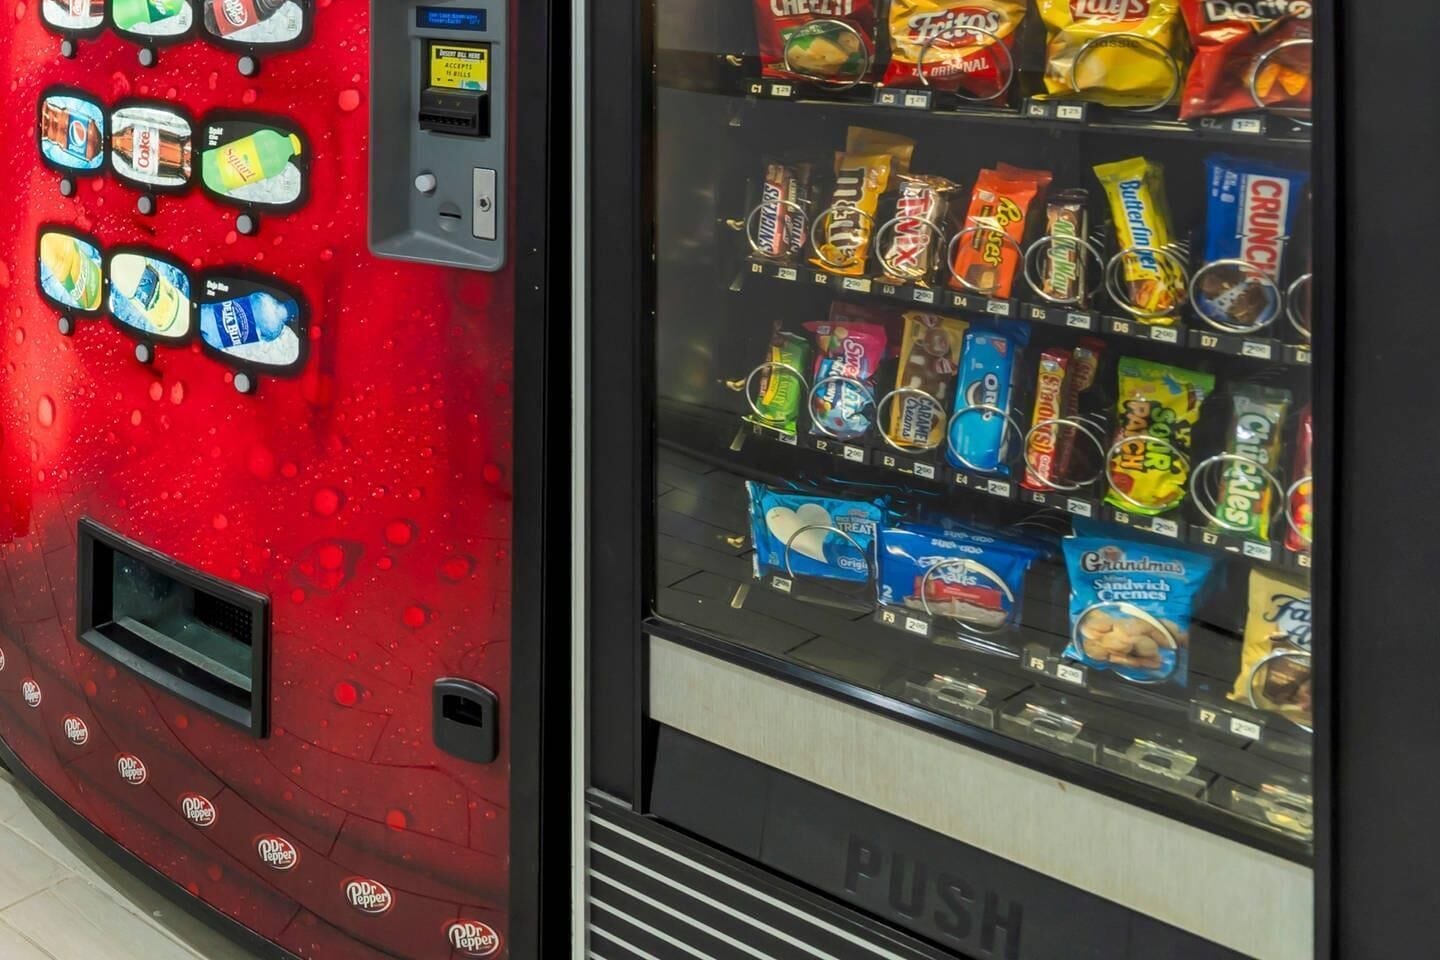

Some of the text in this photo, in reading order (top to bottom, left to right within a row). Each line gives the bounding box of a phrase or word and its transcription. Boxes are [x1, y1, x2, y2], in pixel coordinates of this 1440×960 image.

[908, 10, 1001, 45] Fritos
[138, 131, 149, 168] Coke
[1144, 407, 1176, 470] SOUR
[882, 584, 893, 596] 2
[1093, 578, 1171, 593] Sandwich
[1097, 589, 1167, 601] Cremes
[258, 839, 292, 864] Pepper
[346, 881, 387, 908] Pepper
[844, 833, 1024, 960] PUSH
[448, 923, 495, 951] Pepper
